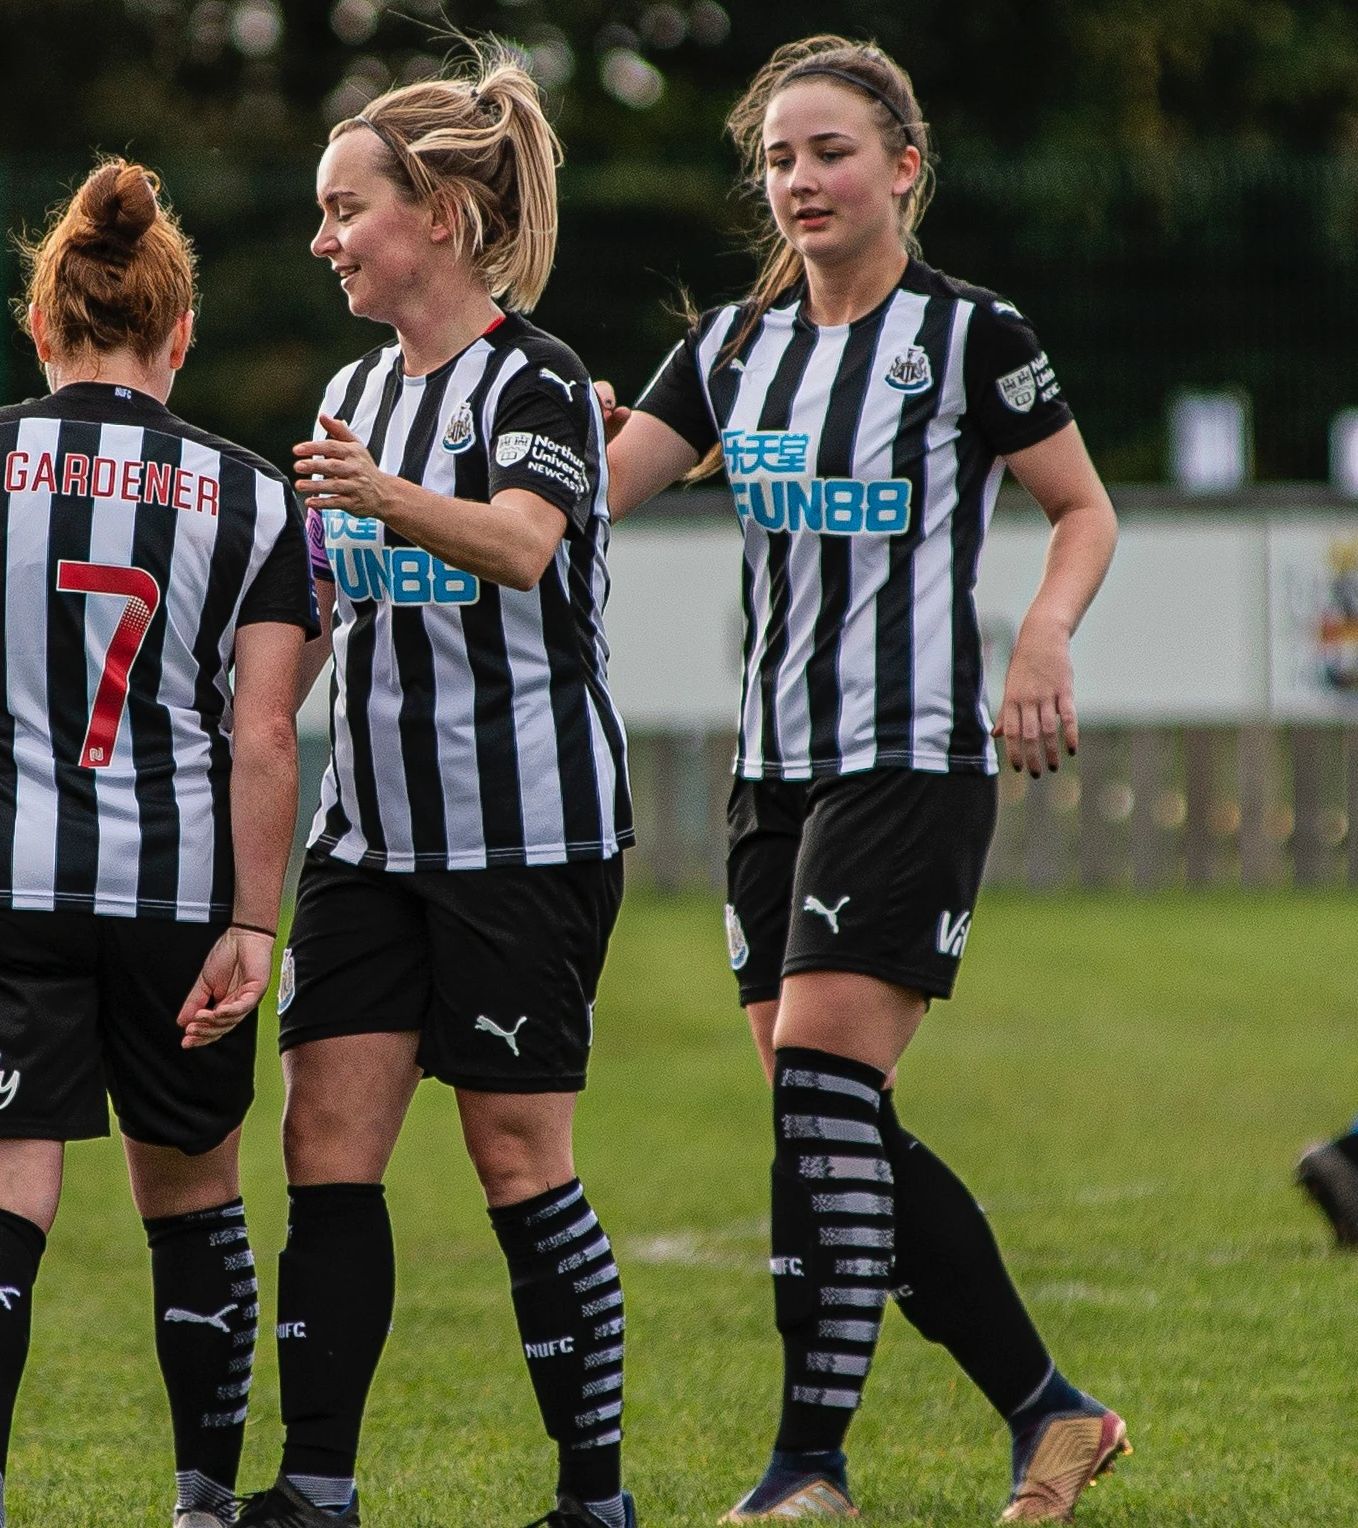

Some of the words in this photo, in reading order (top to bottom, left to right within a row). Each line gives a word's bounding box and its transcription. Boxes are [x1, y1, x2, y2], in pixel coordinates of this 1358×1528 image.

[4, 450, 220, 516] GARDENER
[733, 479, 911, 533] FUN88
[56, 559, 160, 768] 7
[525, 1336, 574, 1359] NUFC
